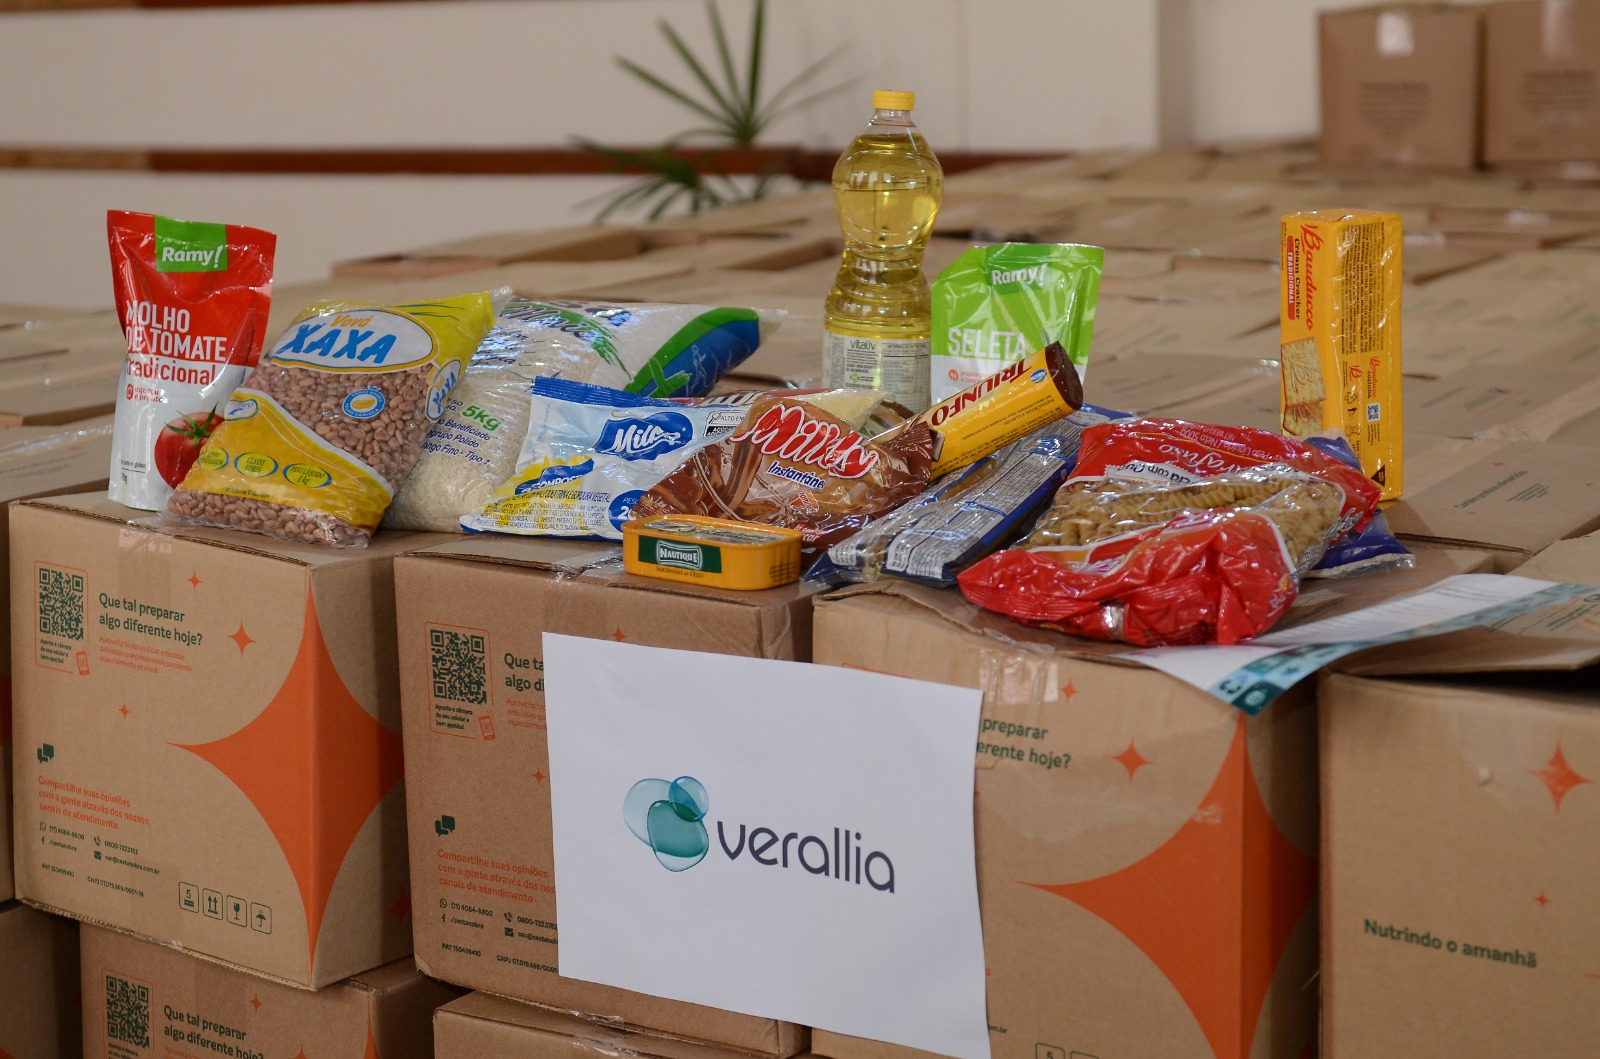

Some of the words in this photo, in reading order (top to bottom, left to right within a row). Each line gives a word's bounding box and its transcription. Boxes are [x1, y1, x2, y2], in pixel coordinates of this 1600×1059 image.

[161, 245, 224, 269] Ramy!
[991, 262, 1047, 287] Ramy!
[1287, 251, 1295, 304] TRADICIONAL
[1300, 223, 1324, 331] Bauducco
[126, 299, 190, 333] MOLHO
[330, 314, 374, 328] Vovô
[126, 326, 145, 352] DE
[150, 328, 228, 362] TOMATE
[275, 322, 397, 364] XAXA
[947, 326, 1026, 360] SELETA
[1369, 356, 1380, 398] Bauducco
[447, 398, 463, 407] ESO
[931, 357, 1032, 427] TRIUNFO
[445, 419, 491, 441] Beneficiado
[462, 404, 501, 432] 5kg
[427, 429, 453, 441] grupo
[454, 434, 479, 449] Polido
[1199, 434, 1218, 446] Neto
[1225, 433, 1236, 441] NET
[423, 441, 442, 453] ongo
[442, 444, 460, 456] Fino
[465, 450, 483, 463] Tipo
[768, 461, 826, 489] Instantâne
[1147, 465, 1169, 477] com
[660, 547, 698, 563] NAUTIQUE
[99, 592, 121, 609] Que
[123, 598, 137, 613] tal
[139, 602, 185, 623] preparar
[99, 613, 121, 630] algo
[123, 616, 172, 640] diferente
[174, 628, 203, 647] hoje?
[504, 652, 530, 669] Que
[532, 658, 544, 672] ta
[505, 674, 531, 692] algo
[982, 717, 1049, 740] preparar
[977, 740, 1025, 762] erente
[1028, 747, 1072, 769] hoje?
[39, 775, 82, 795] Compartilhe
[83, 789, 100, 799] suas
[100, 793, 131, 808] opiniões
[39, 790, 54, 799] com
[60, 795, 81, 807] gente
[82, 799, 109, 815] através
[110, 808, 123, 818] dos
[124, 813, 149, 825] nossos
[39, 803, 61, 815] canais
[63, 807, 72, 816] de
[73, 811, 118, 829] atendimento
[437, 849, 489, 867] Compartilhe
[491, 861, 510, 872] suas
[512, 865, 548, 879] opiniões
[717, 820, 895, 894] verallia
[438, 864, 456, 874] com
[464, 869, 488, 881] gente
[490, 873, 521, 887] através
[523, 880, 539, 891] dos
[540, 885, 556, 894] nos
[439, 877, 465, 889] canais
[466, 882, 477, 891] de
[478, 886, 534, 903] atendimento
[186, 889, 191, 899] 5
[442, 943, 452, 951] PAT
[1364, 917, 1441, 951] Nutrindo
[1447, 939, 1458, 953] o
[1462, 941, 1538, 969] amanhã
[497, 954, 511, 964] CNPJ
[163, 1004, 185, 1022] Que
[187, 1011, 200, 1027] tal
[202, 1017, 247, 1041] preparar
[164, 1025, 185, 1043] algo
[187, 1029, 234, 1053] diferente
[236, 1043, 264, 1059] hoje?
